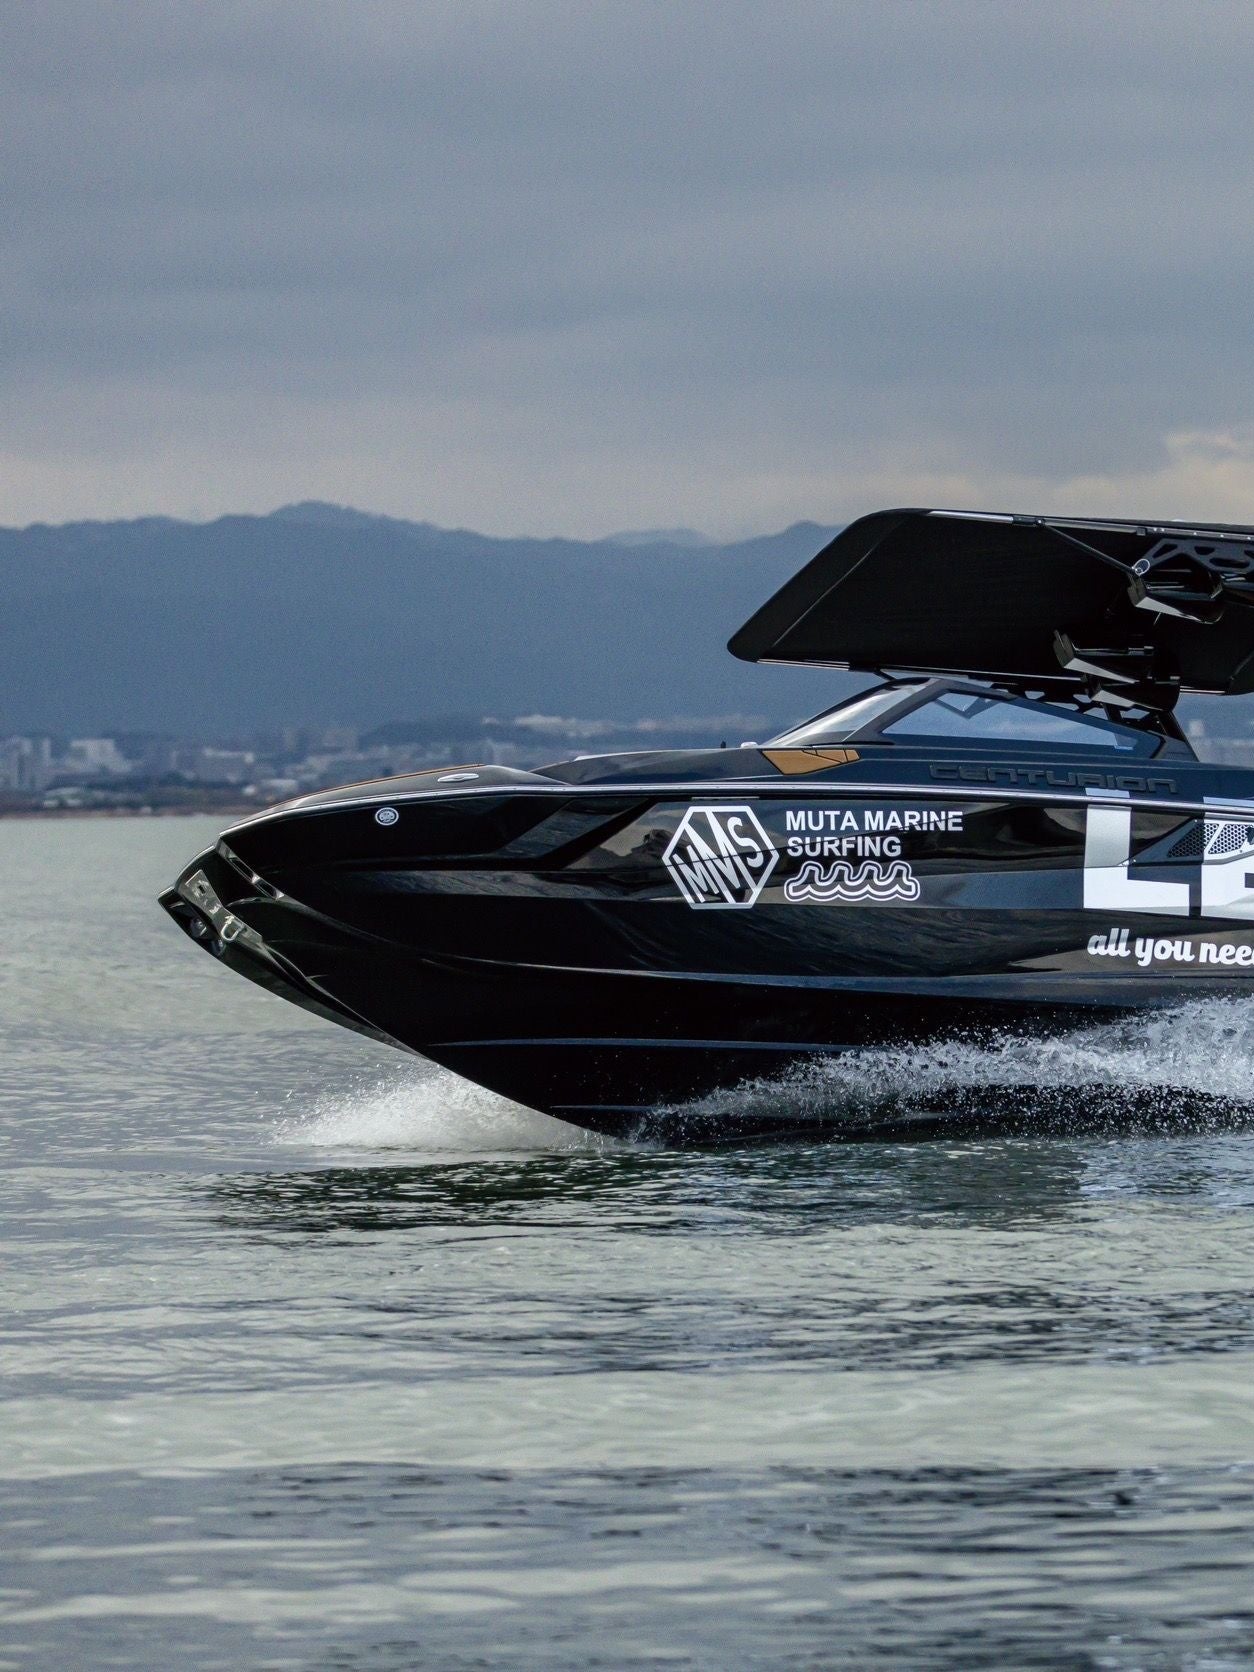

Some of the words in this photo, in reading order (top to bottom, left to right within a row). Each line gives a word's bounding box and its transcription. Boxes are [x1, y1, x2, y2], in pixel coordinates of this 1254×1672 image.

[929, 765, 1177, 793] CENTURION
[786, 811, 858, 831] MUTA
[864, 811, 963, 831] MARINE
[787, 836, 901, 857] SURFING
[1087, 928, 1131, 957] all
[1134, 938, 1195, 967] you
